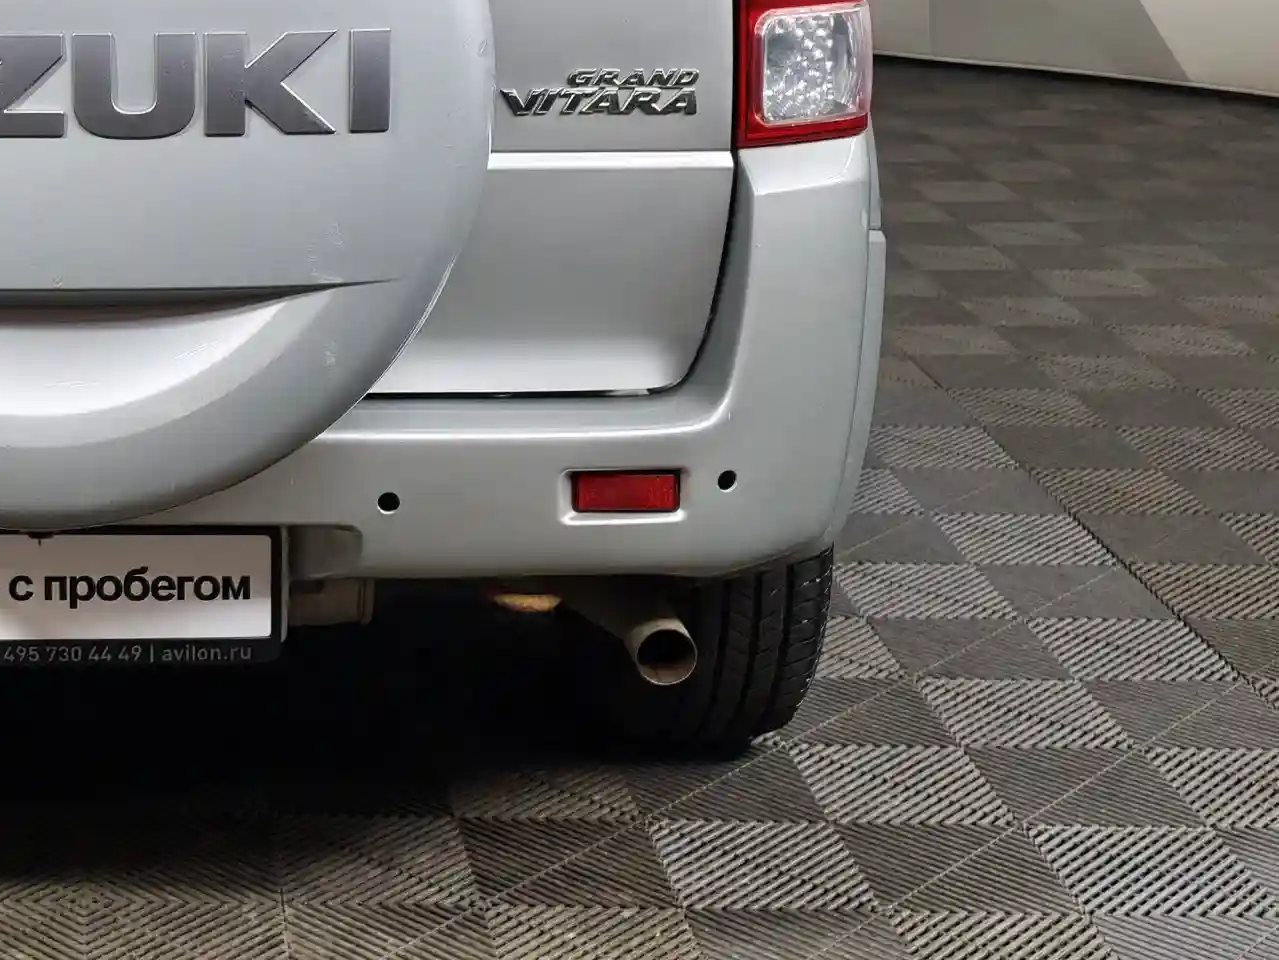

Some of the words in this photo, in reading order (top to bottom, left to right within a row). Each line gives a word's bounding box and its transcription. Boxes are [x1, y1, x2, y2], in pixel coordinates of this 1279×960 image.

[567, 68, 699, 87] GRAND
[500, 87, 697, 116] VITARA
[9, 575, 34, 601] с
[44, 566, 251, 609] пробегом
[3, 646, 40, 662] 495
[46, 646, 82, 662] 730
[88, 646, 113, 662] 44
[118, 645, 143, 662] 49
[161, 643, 252, 662] avilon.ru
